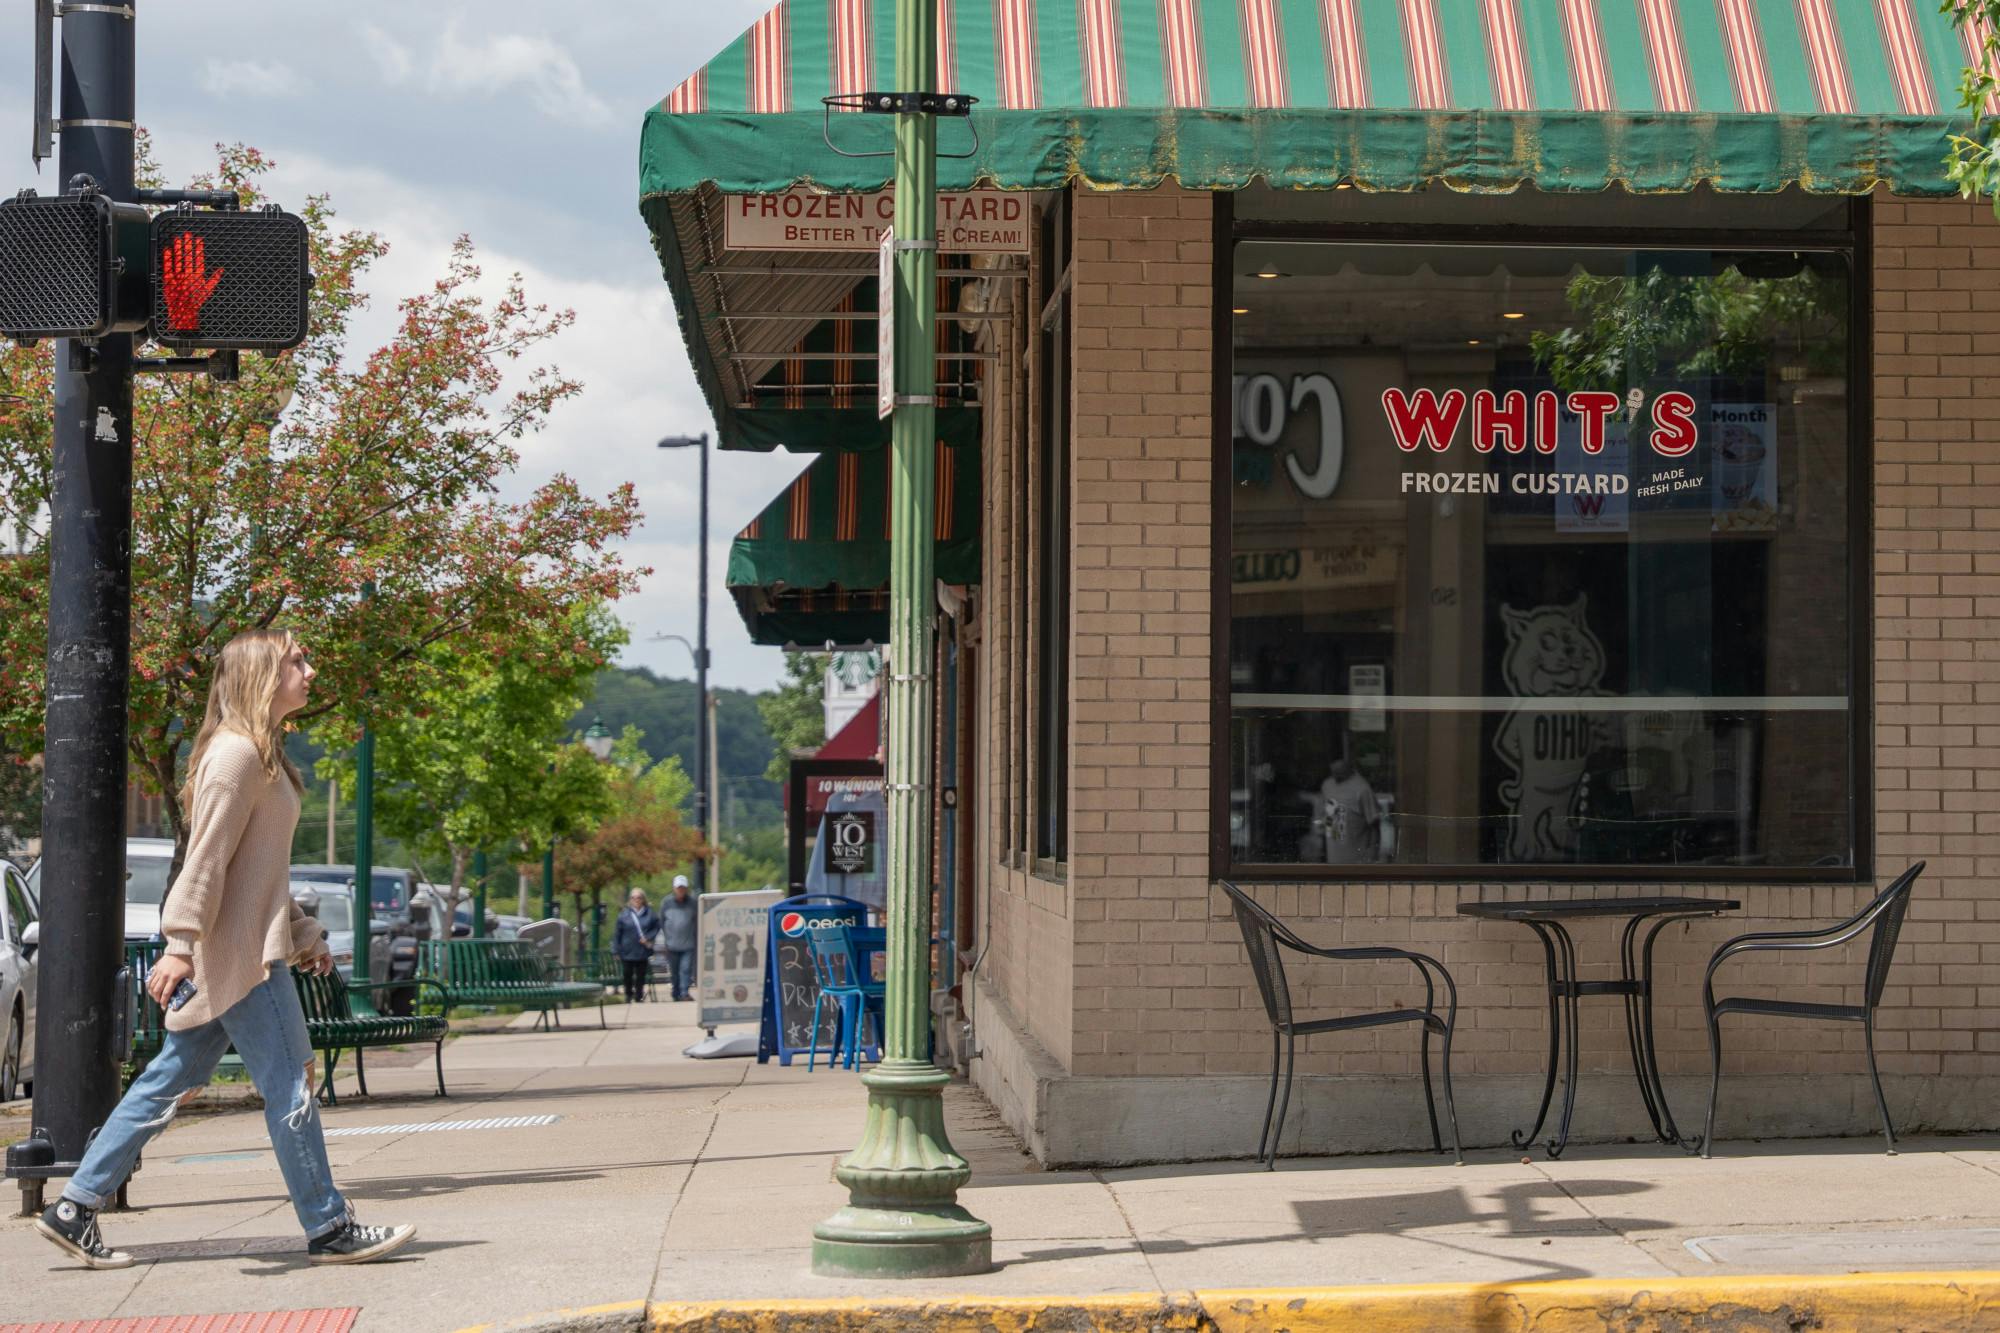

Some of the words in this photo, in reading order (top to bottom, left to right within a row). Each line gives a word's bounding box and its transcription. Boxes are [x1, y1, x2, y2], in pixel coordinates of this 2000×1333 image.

[742, 195, 863, 219] FROZEN
[876, 195, 1021, 220] CTARD
[784, 225, 856, 242] BETTER
[952, 226, 1021, 243] CREAM!
[1382, 387, 1697, 457] WHIT'S
[1712, 409, 1767, 422] Month
[1401, 472, 1500, 493] FROZEN
[1511, 473, 1629, 495] CUSTARD
[1652, 468, 1685, 483] MADE
[1637, 483, 1670, 498] FRESH
[1674, 476, 1704, 491] DAILY
[832, 822, 866, 846] 10
[832, 846, 866, 858] WEST
